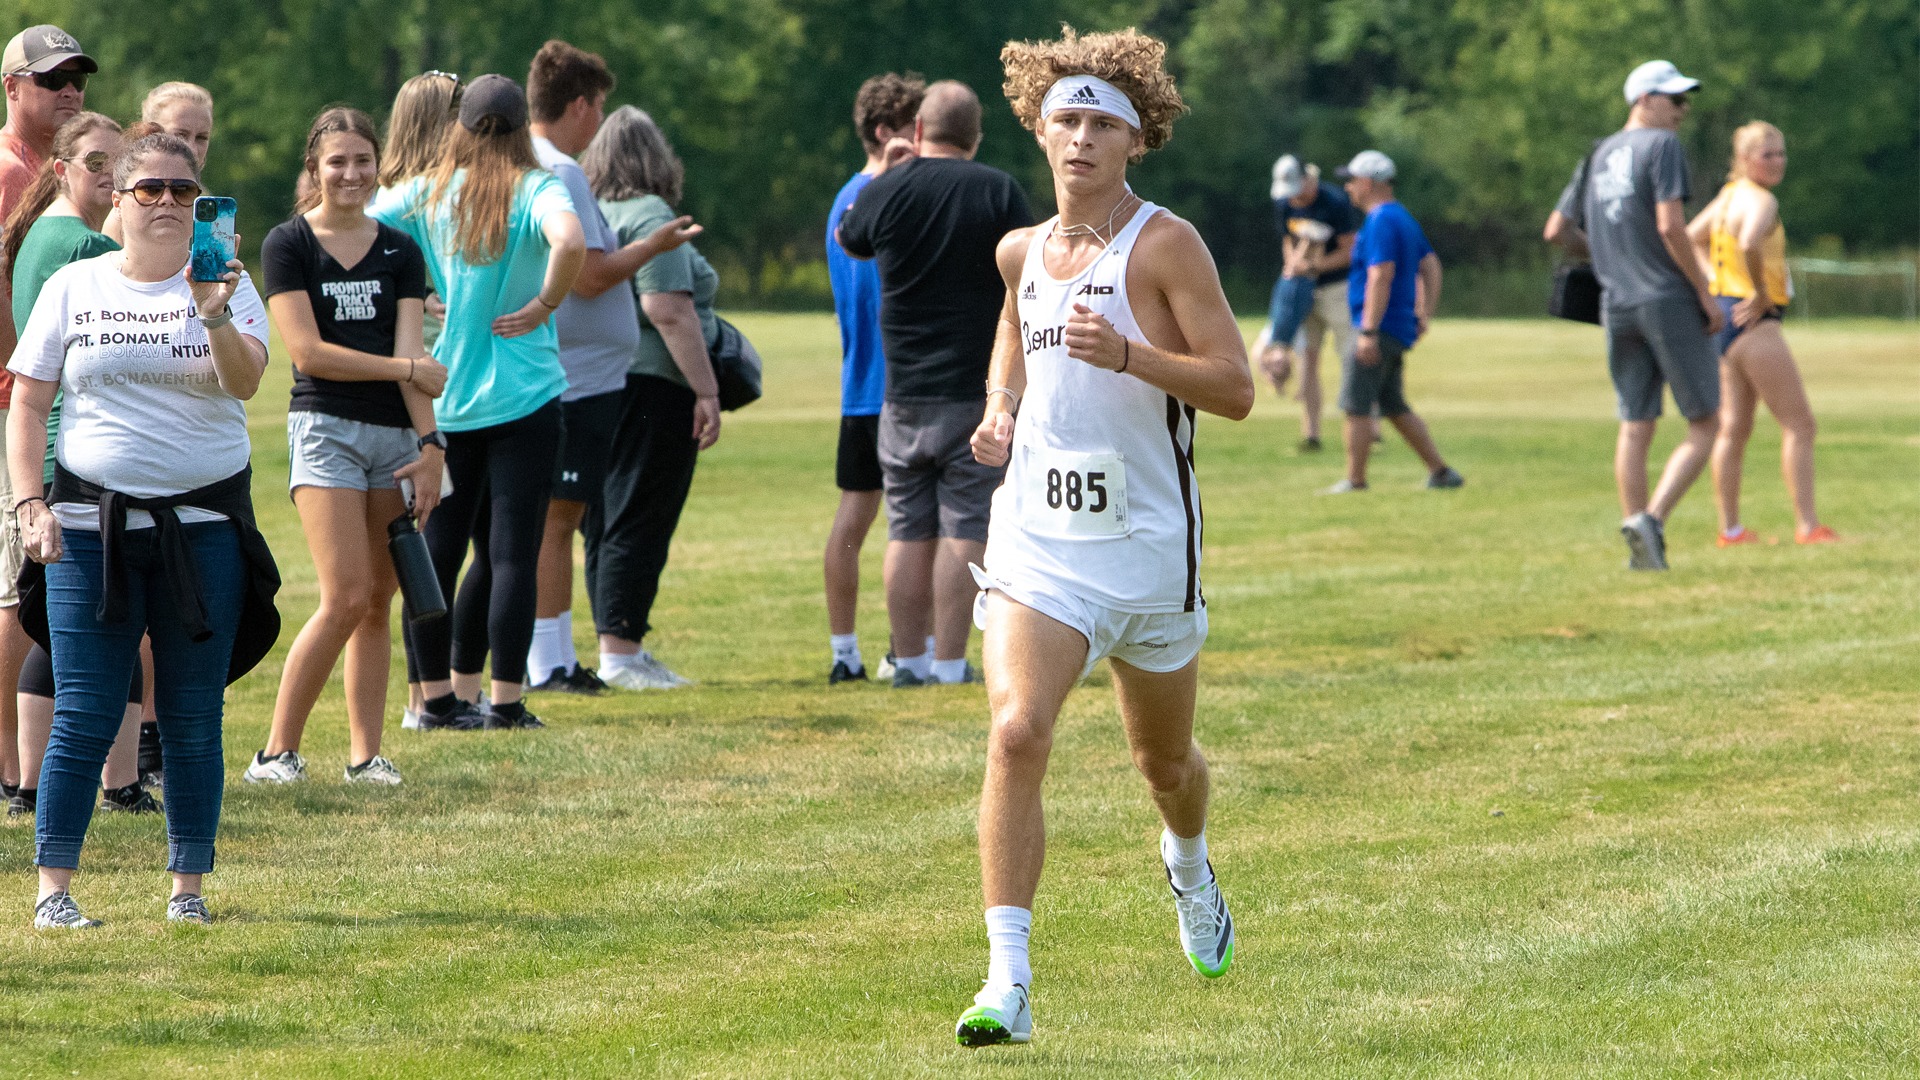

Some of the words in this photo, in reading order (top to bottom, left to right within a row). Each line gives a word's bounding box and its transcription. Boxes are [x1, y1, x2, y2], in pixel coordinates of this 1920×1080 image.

[1067, 97, 1101, 106] adidas
[321, 280, 382, 296] FRONTIER
[334, 293, 374, 307] TRACK
[75, 311, 95, 325] ST.
[101, 306, 197, 324] BONAVENTU
[345, 306, 377, 320] FIELD
[100, 332, 209, 345] BONAVENTUR
[100, 345, 211, 358] BONAVENTUR
[78, 375, 98, 388] ST.
[103, 373, 218, 386] BONAVENTUR
[1046, 467, 1108, 513] 885
